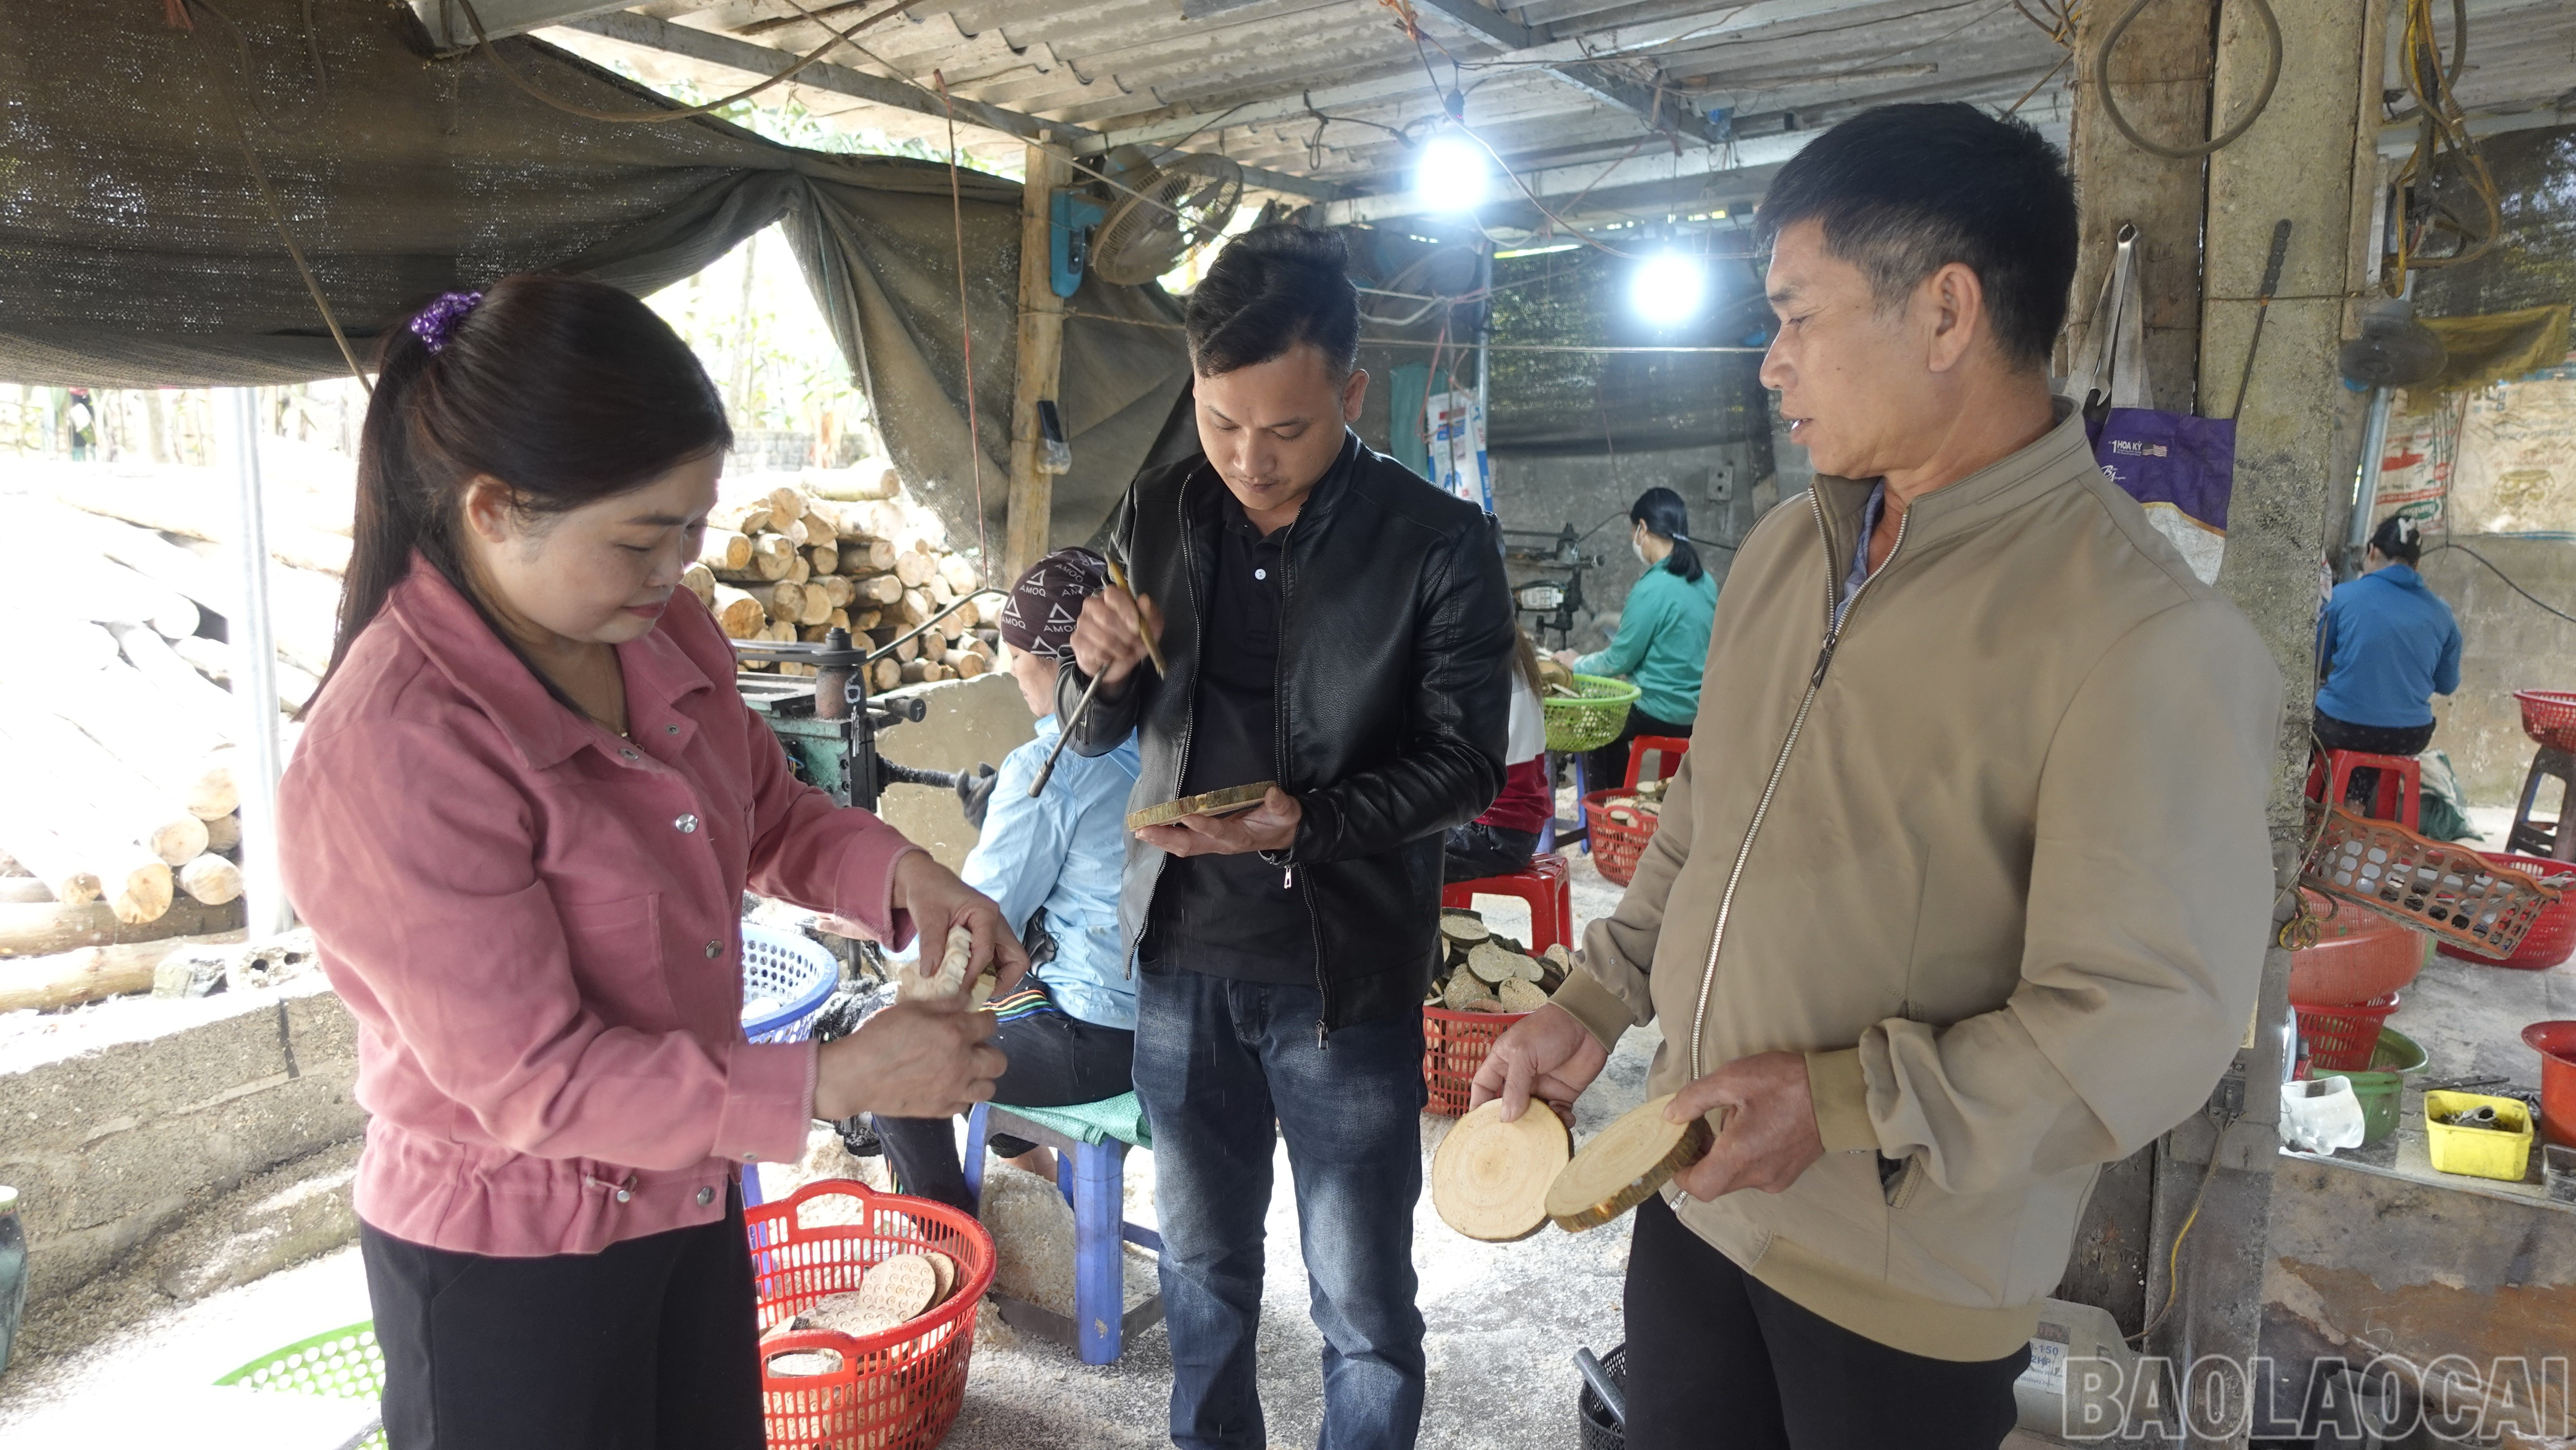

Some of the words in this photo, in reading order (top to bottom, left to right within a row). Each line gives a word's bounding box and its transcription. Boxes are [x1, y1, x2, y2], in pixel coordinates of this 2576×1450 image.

[2117, 440, 2132, 451] HOA
[1019, 584, 1046, 597] AMOQ
[1001, 616, 1026, 630] AMOQ
